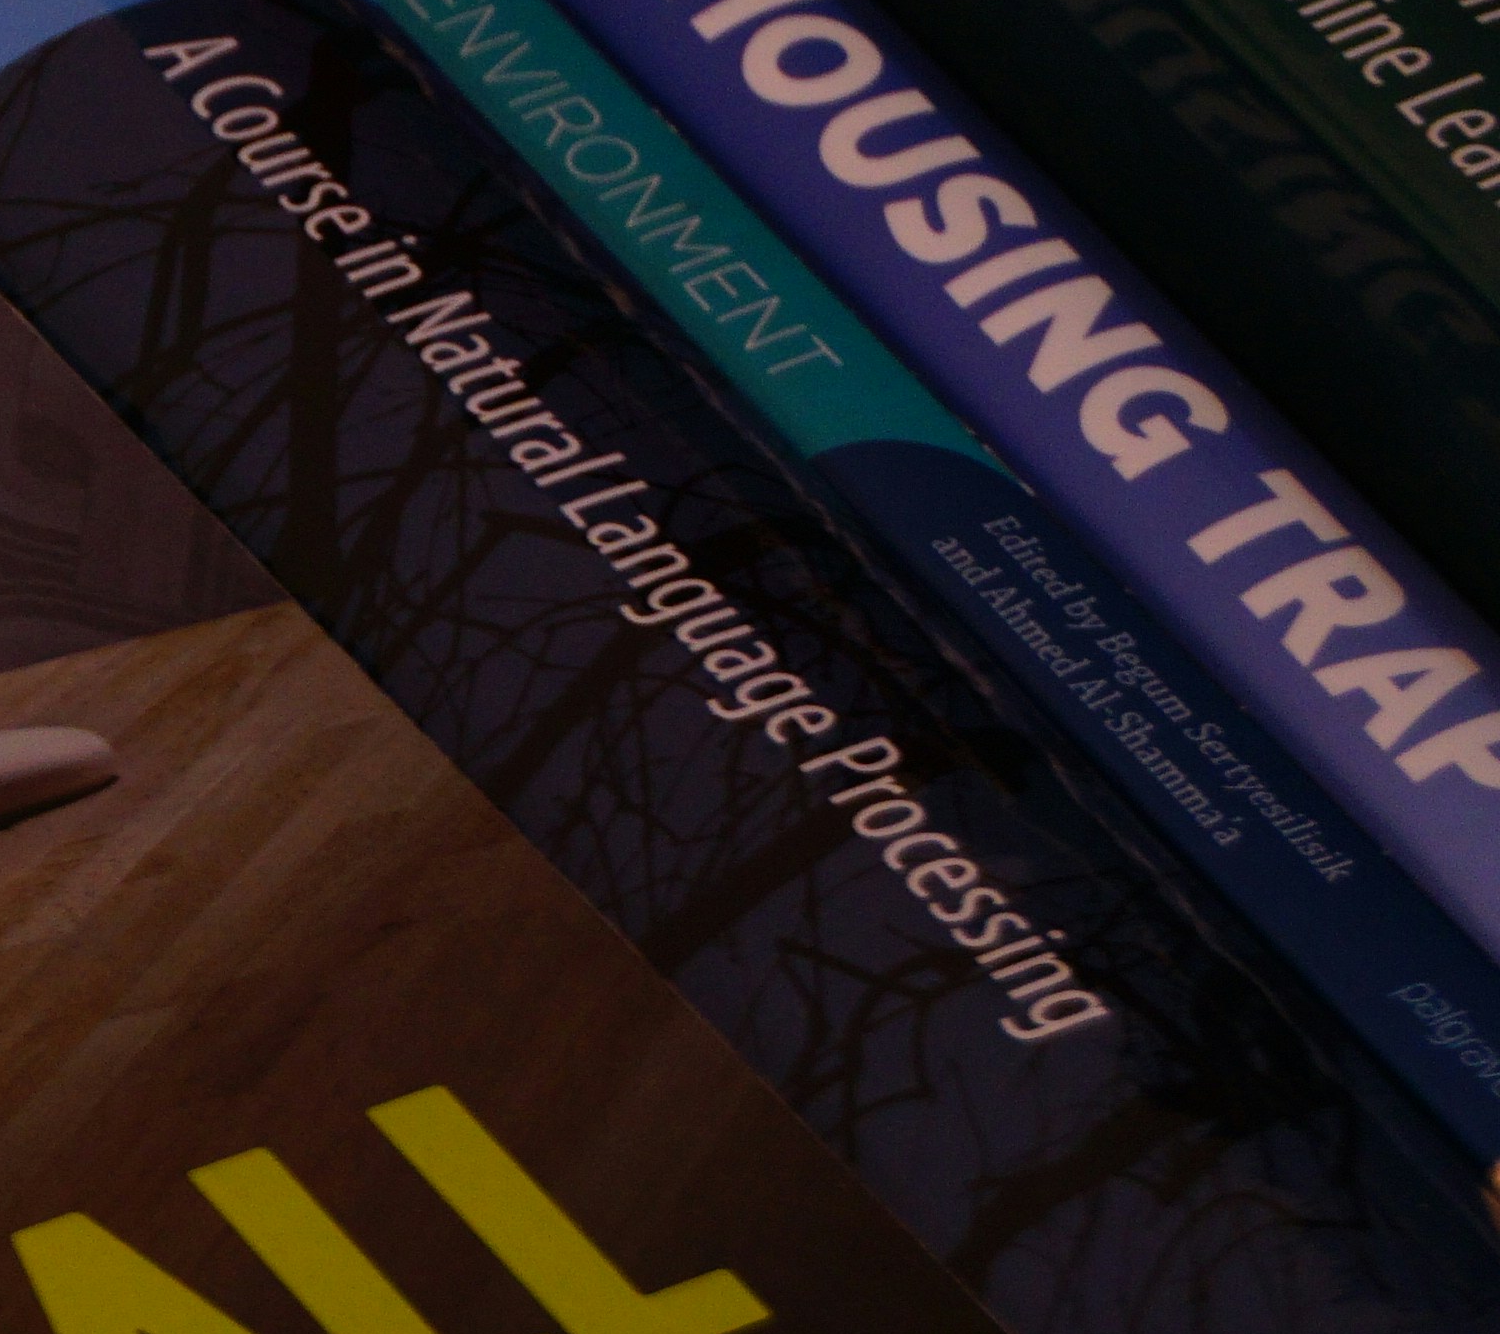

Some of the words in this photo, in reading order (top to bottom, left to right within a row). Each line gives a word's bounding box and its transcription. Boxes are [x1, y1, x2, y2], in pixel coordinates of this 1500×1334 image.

[143, 35, 238, 82] A
[190, 73, 371, 245] Course
[347, 234, 423, 299] in
[388, 291, 619, 487] Natural
[560, 479, 838, 746] Language
[931, 536, 1004, 587] and
[980, 585, 1091, 679] Ahmed
[983, 514, 1086, 601] Edited
[1065, 593, 1107, 631] by
[1096, 631, 1193, 724] Begum
[1186, 468, 1500, 790] TRAP
[801, 736, 1110, 1041] Processing
